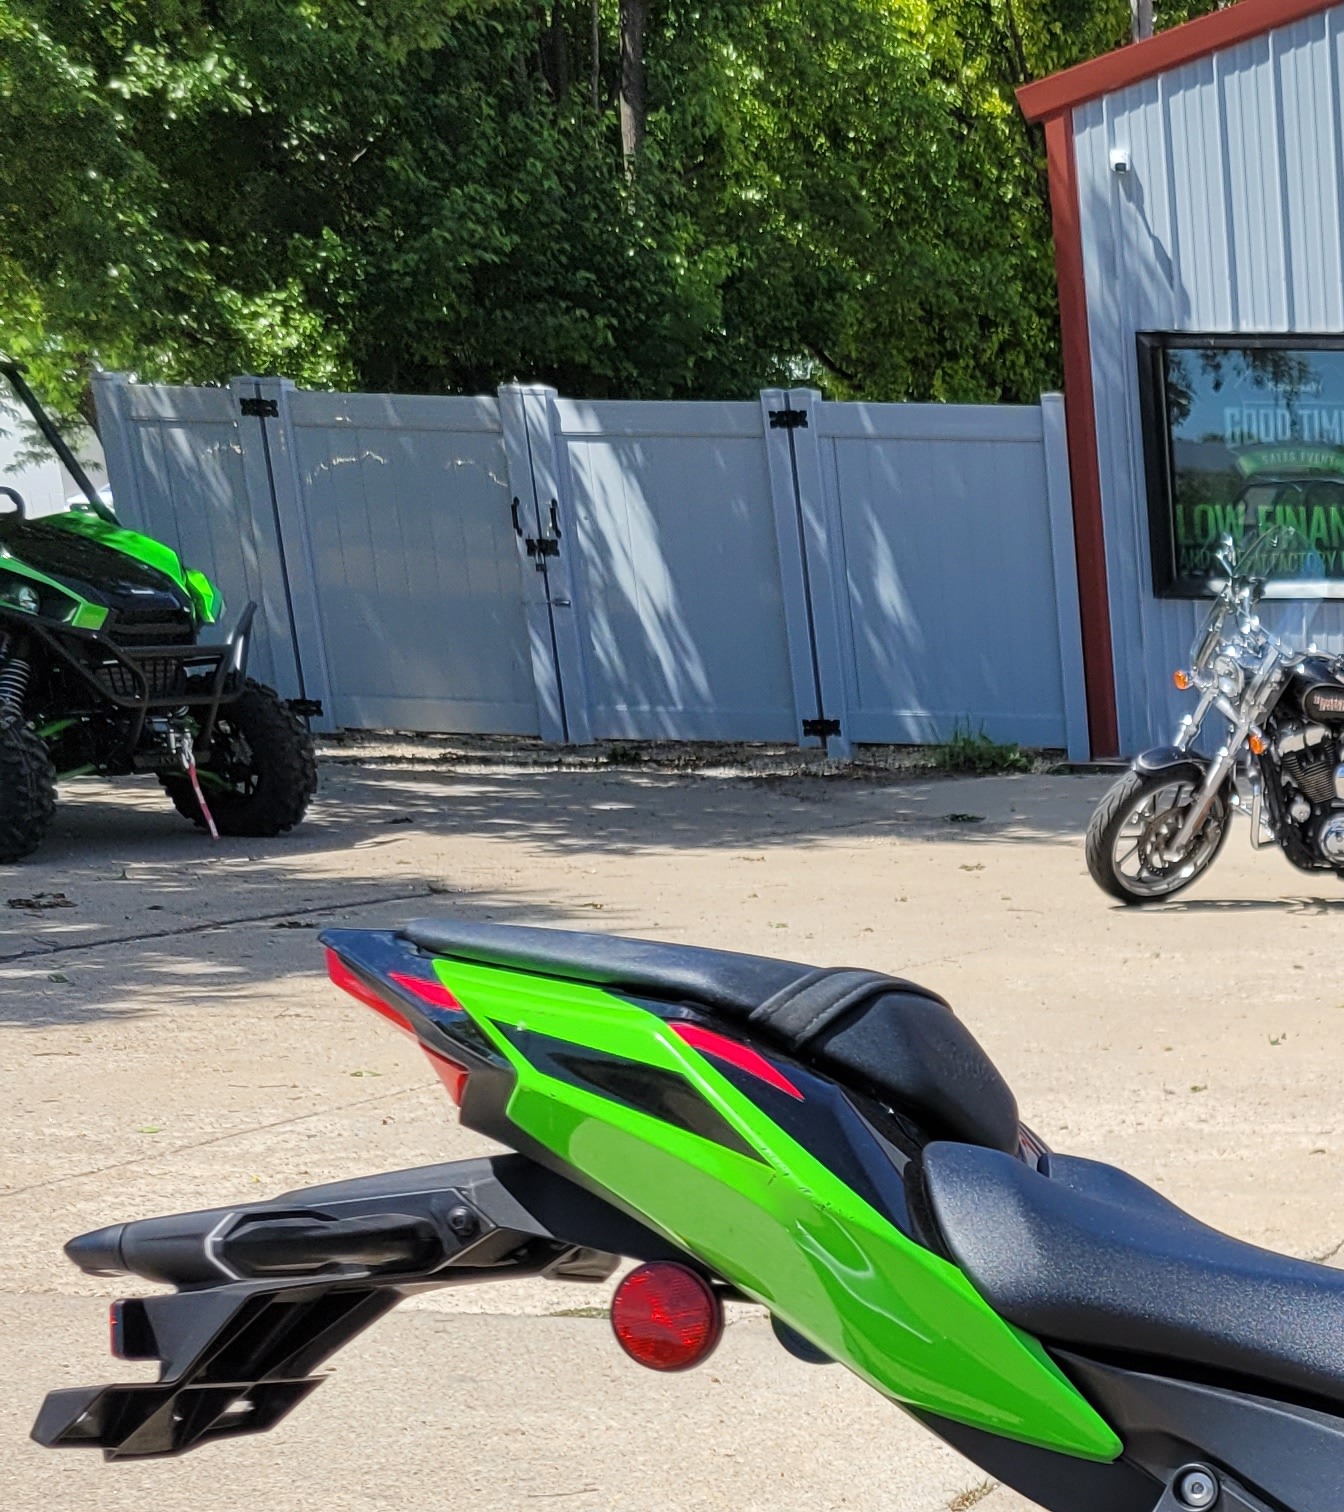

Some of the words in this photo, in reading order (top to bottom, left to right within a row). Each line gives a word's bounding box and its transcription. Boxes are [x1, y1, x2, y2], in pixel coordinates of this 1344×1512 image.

[1224, 406, 1291, 447] GOOD
[1262, 452, 1297, 465] SALES
[1300, 452, 1336, 465] EVENT
[1176, 504, 1245, 545] LOW
